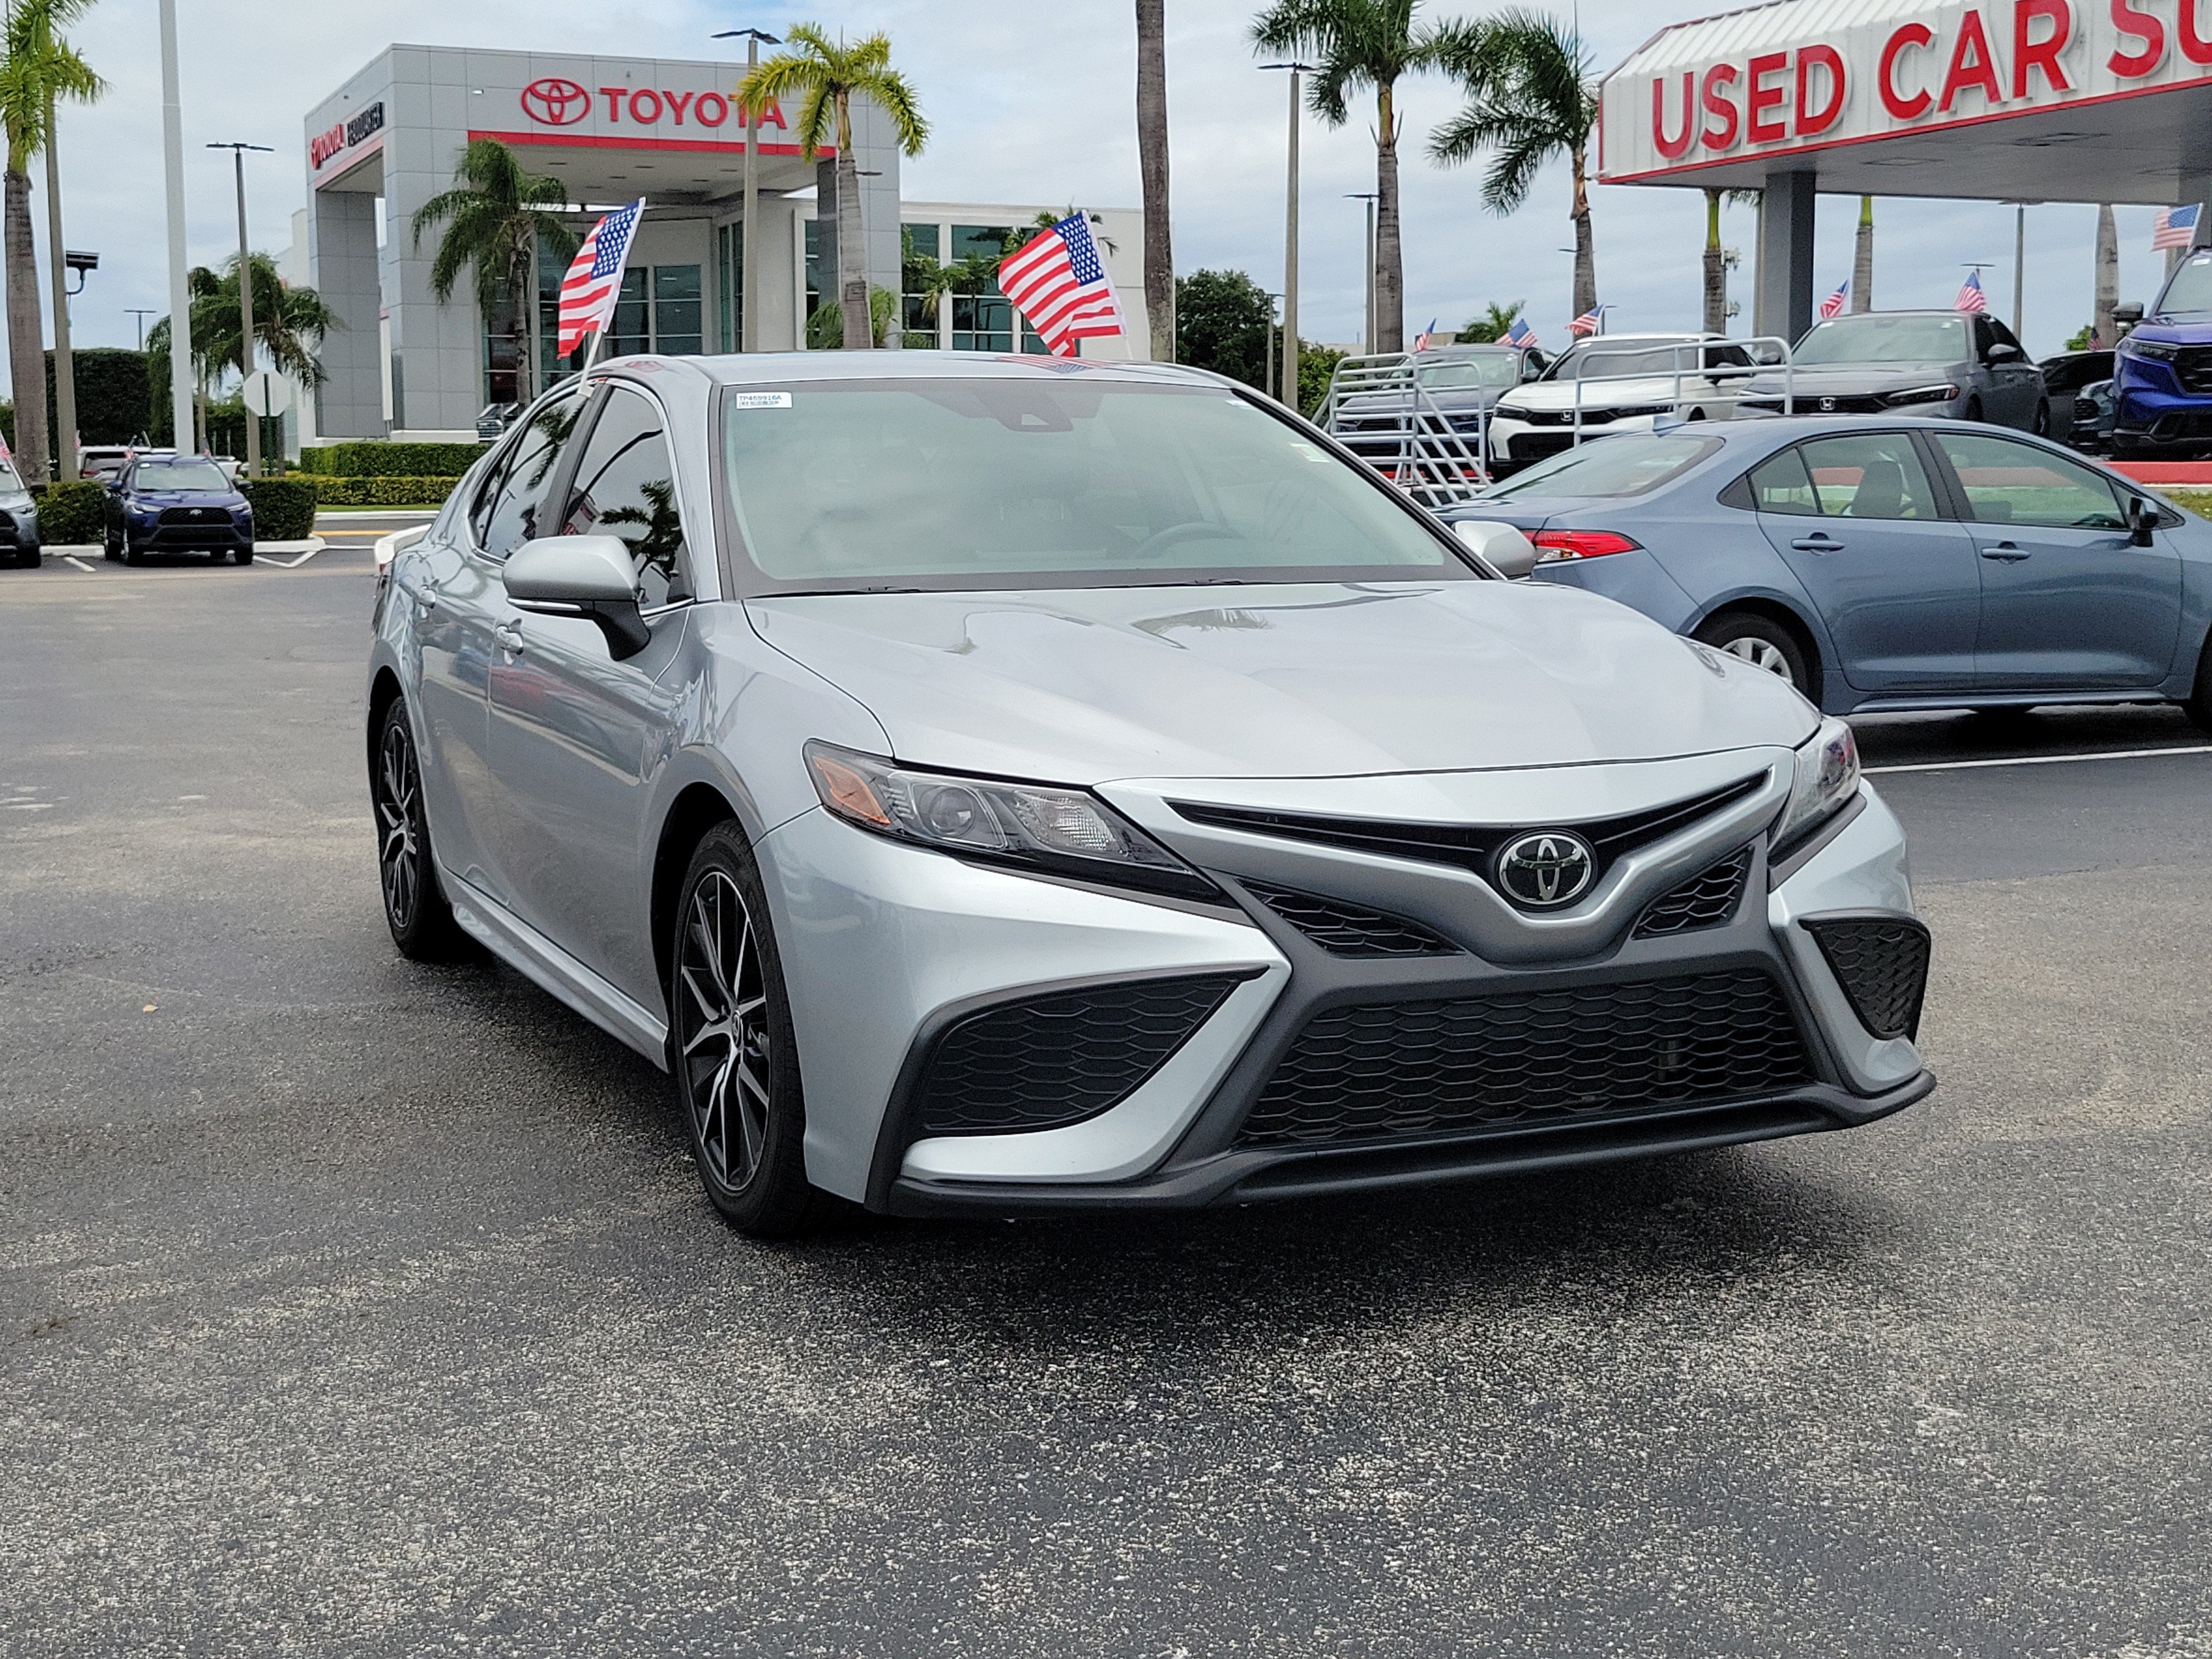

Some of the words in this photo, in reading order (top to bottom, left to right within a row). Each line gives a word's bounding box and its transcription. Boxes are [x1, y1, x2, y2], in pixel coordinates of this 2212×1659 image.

[599, 87, 788, 129] TOYOTA
[1652, 43, 1847, 160] USED
[1878, 0, 2071, 120] CAR
